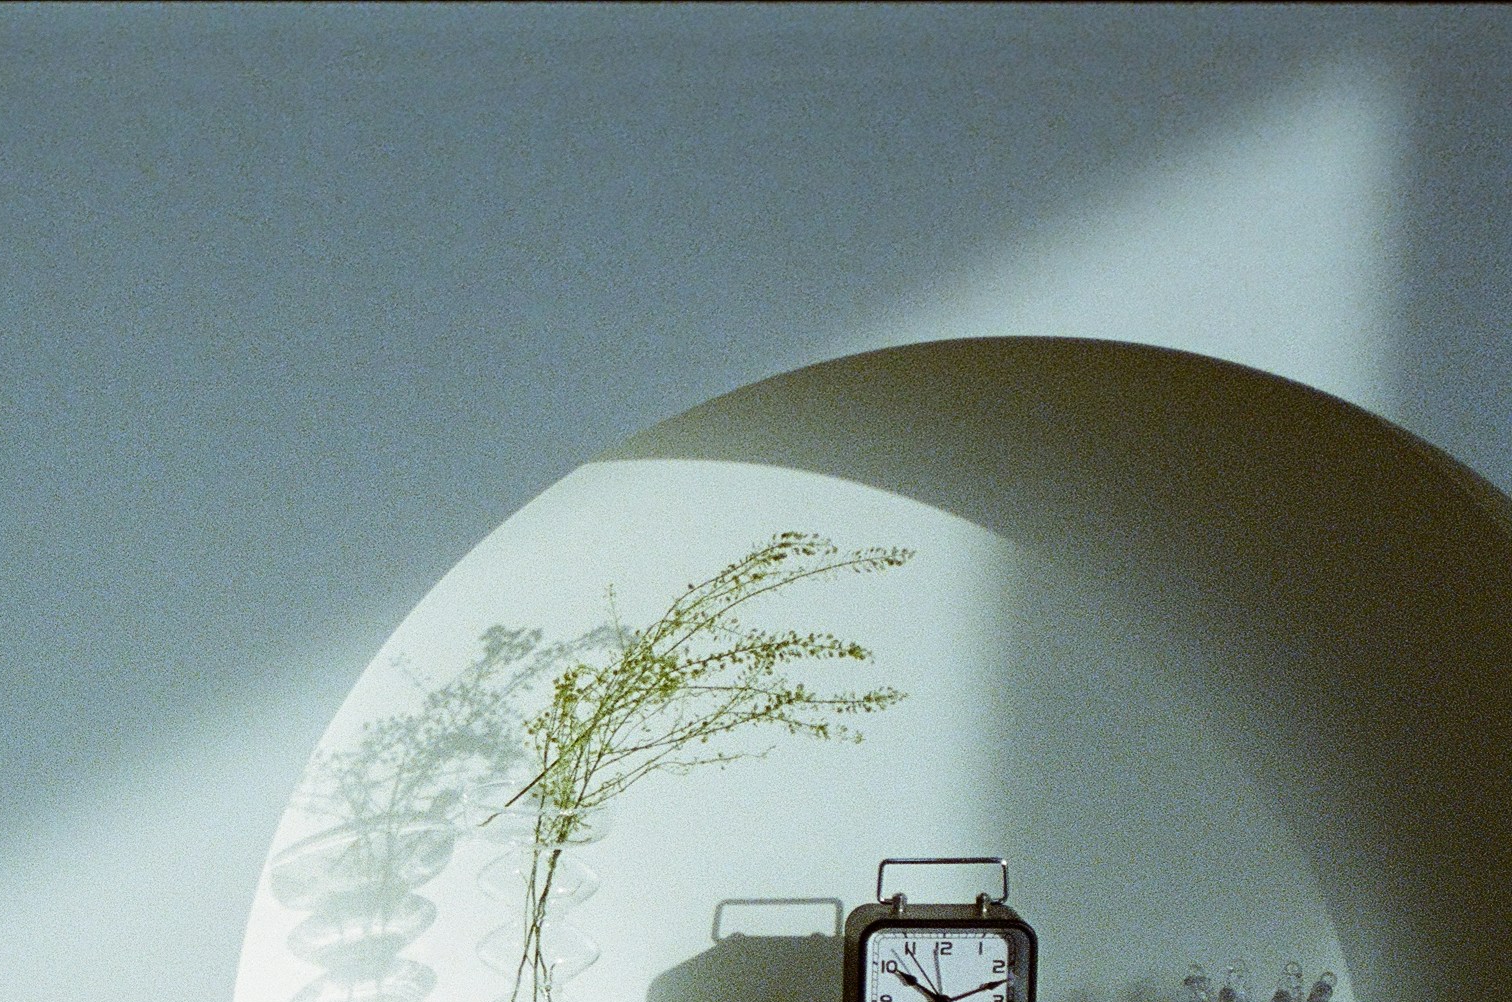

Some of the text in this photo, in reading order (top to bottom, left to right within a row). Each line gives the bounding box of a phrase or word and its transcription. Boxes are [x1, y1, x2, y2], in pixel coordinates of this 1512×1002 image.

[904, 942, 916, 955] 11
[934, 942, 952, 955] 12
[978, 942, 983, 955] 1
[881, 960, 897, 973] 10
[992, 960, 1005, 973] 2
